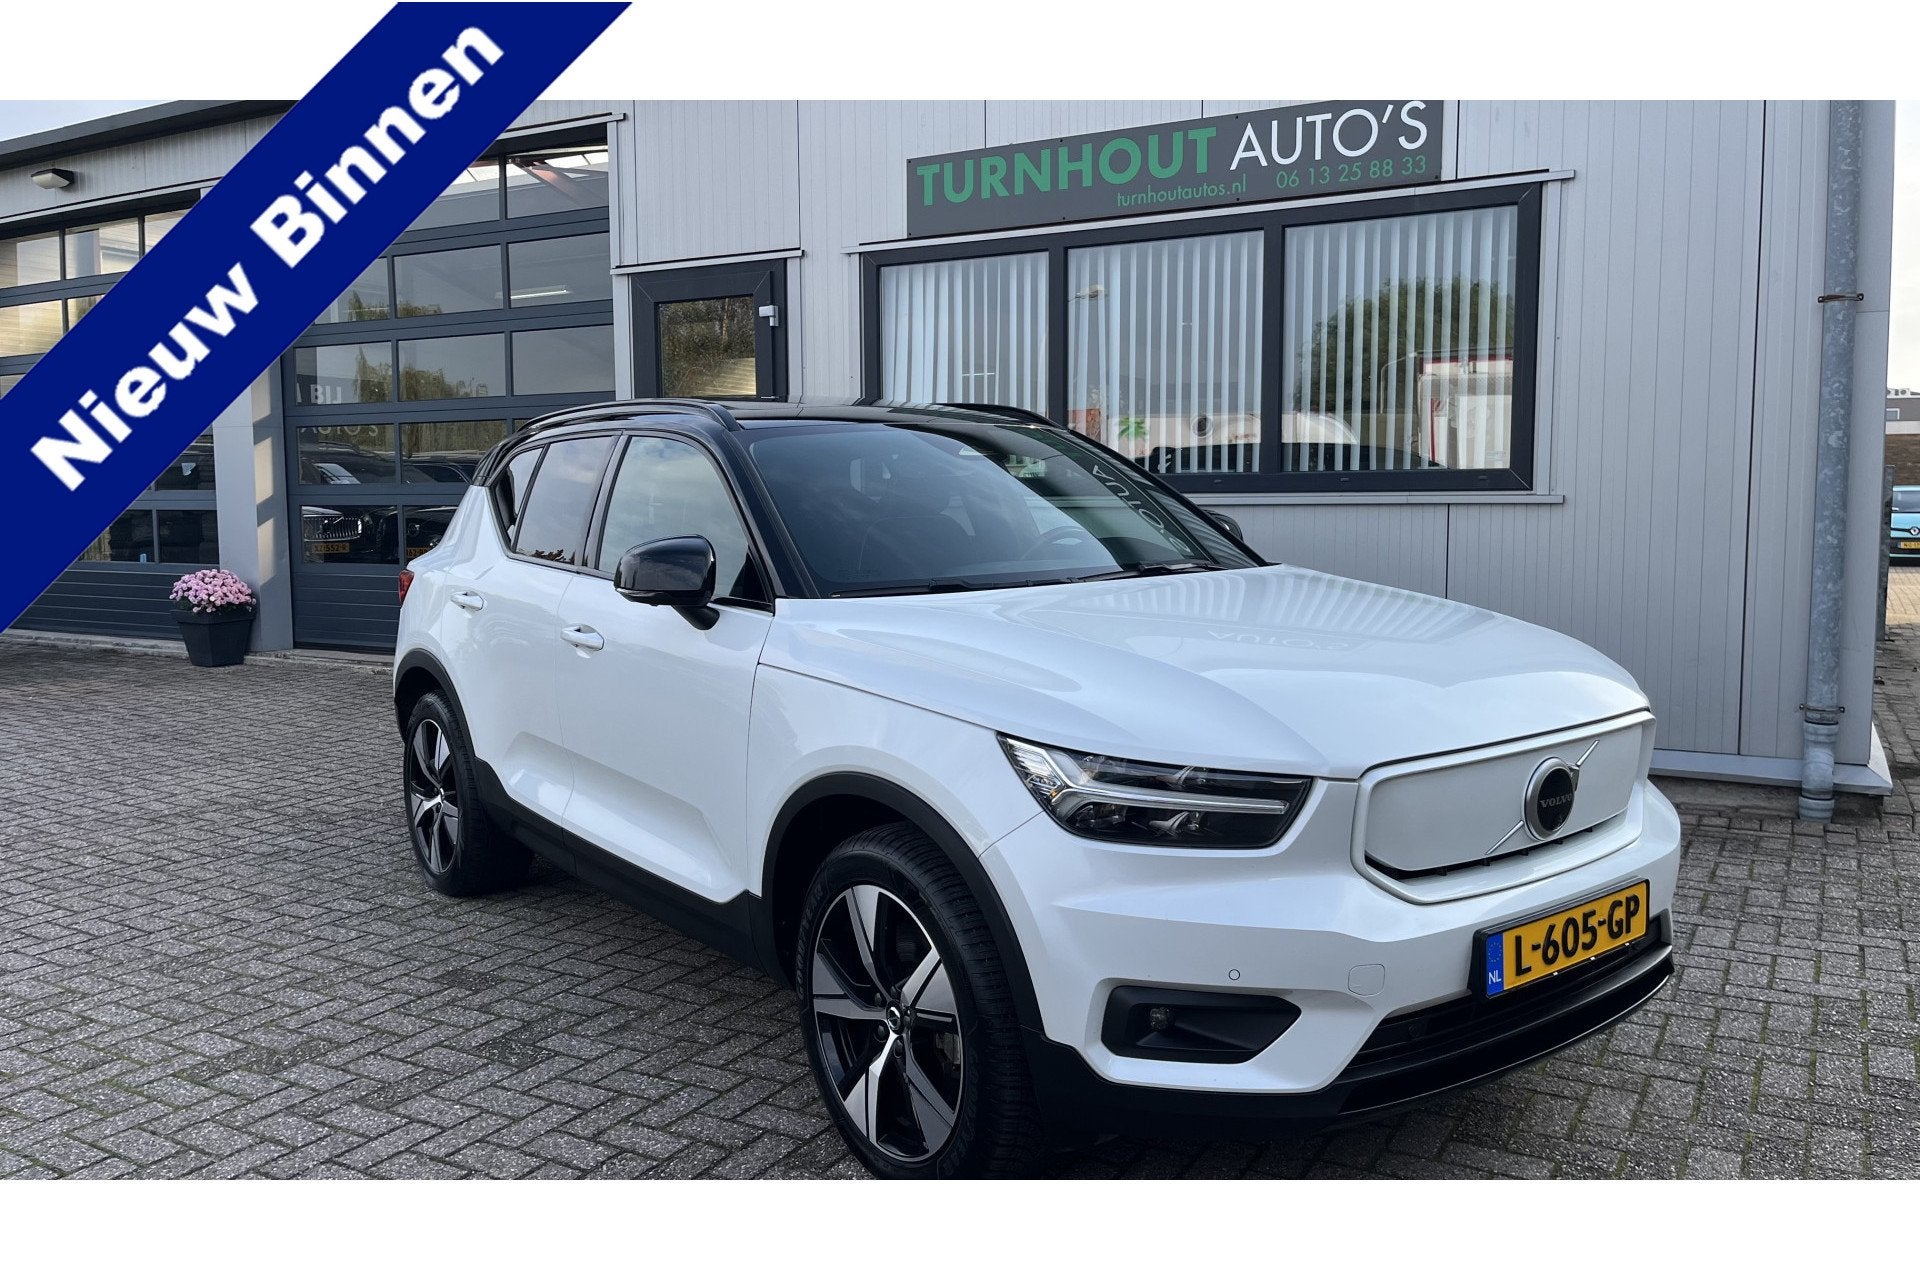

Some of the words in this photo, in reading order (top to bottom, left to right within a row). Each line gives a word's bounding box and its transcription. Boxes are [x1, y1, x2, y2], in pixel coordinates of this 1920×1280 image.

[917, 127, 1217, 206] TURNHOUT
[1229, 100, 1428, 171] AUTO'S
[1276, 169, 1300, 189] 06
[1308, 166, 1331, 185] 13
[1338, 162, 1362, 182] 25
[1369, 158, 1393, 179] 88
[1401, 155, 1427, 176] 33
[1116, 174, 1247, 207] turnhoutautos.nl
[1540, 793, 1572, 808] VOLVO
[1488, 969, 1502, 984] NL
[1514, 893, 1641, 978] L-605-GP
